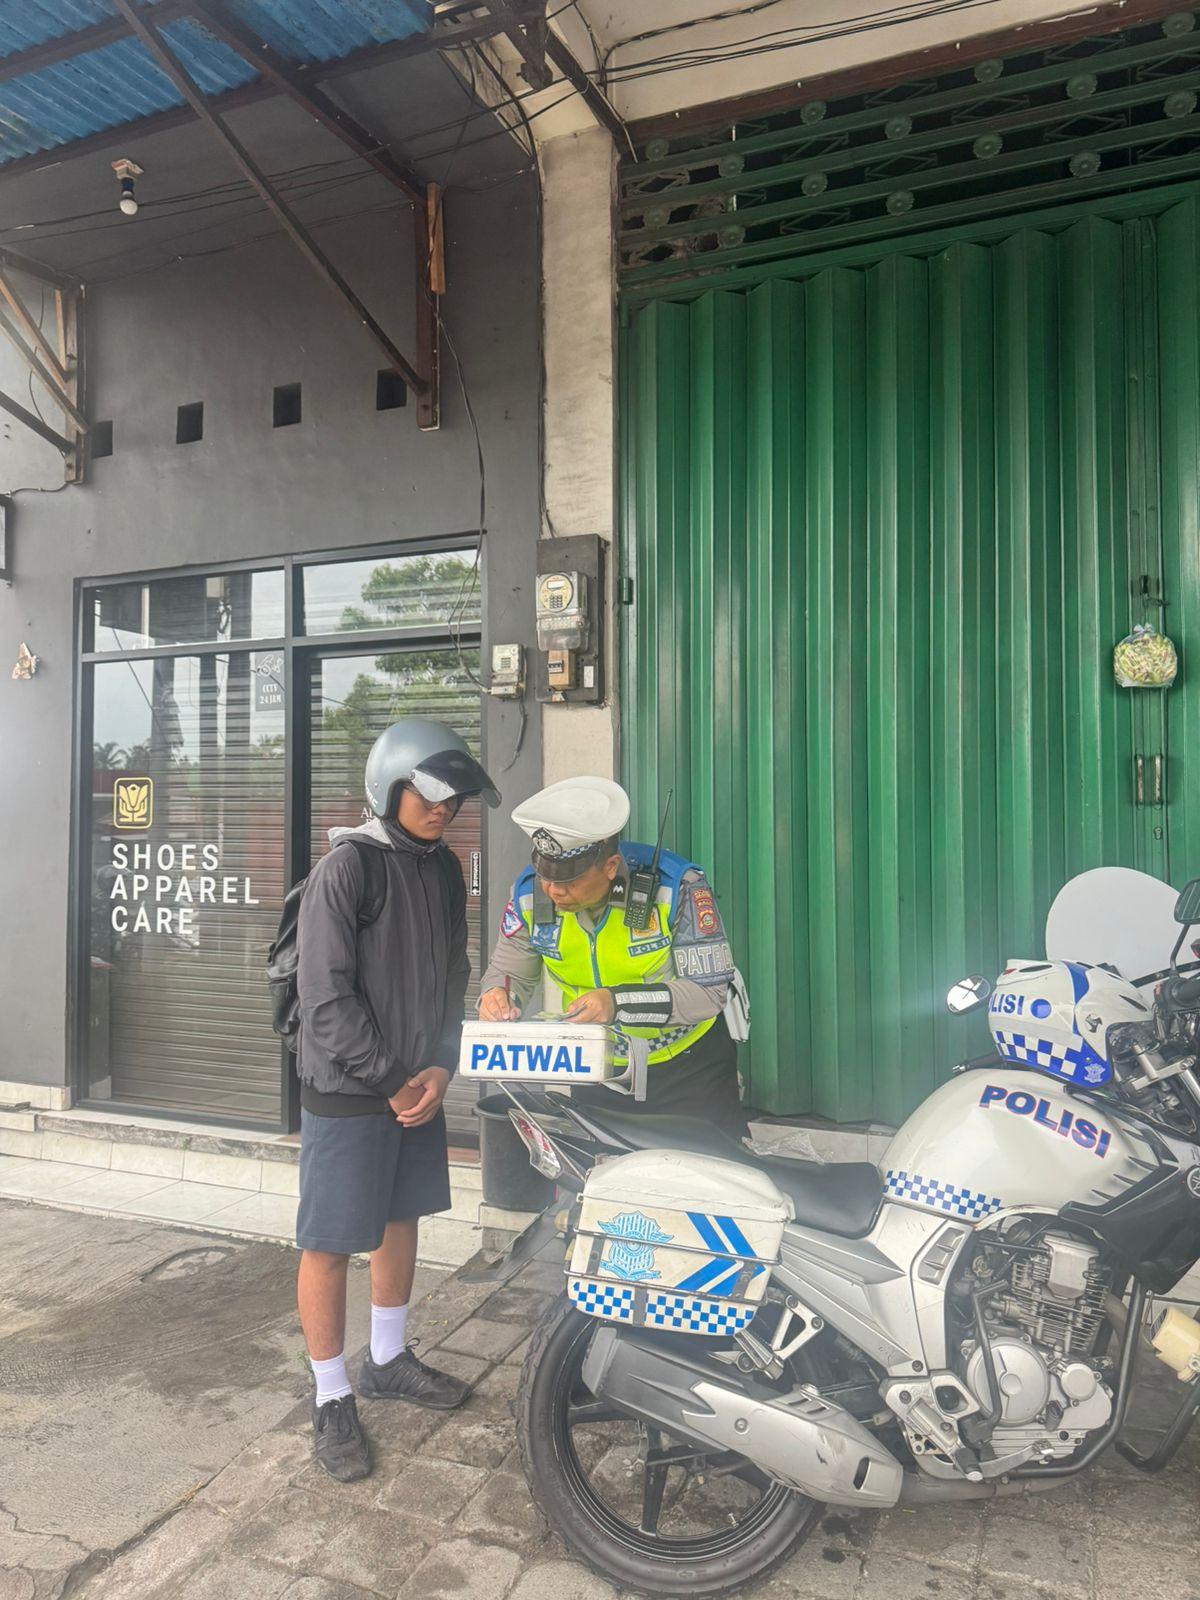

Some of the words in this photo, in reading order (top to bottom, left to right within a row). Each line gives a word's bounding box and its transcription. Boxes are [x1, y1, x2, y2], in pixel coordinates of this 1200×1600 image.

[112, 843, 219, 871] SHOES
[110, 874, 260, 904] APPAREL
[111, 905, 194, 935] CARE
[632, 938, 669, 954] POLRI
[989, 993, 1025, 1015] LISI
[471, 1044, 591, 1073] PATWAL
[978, 1085, 1111, 1158] POLISI
